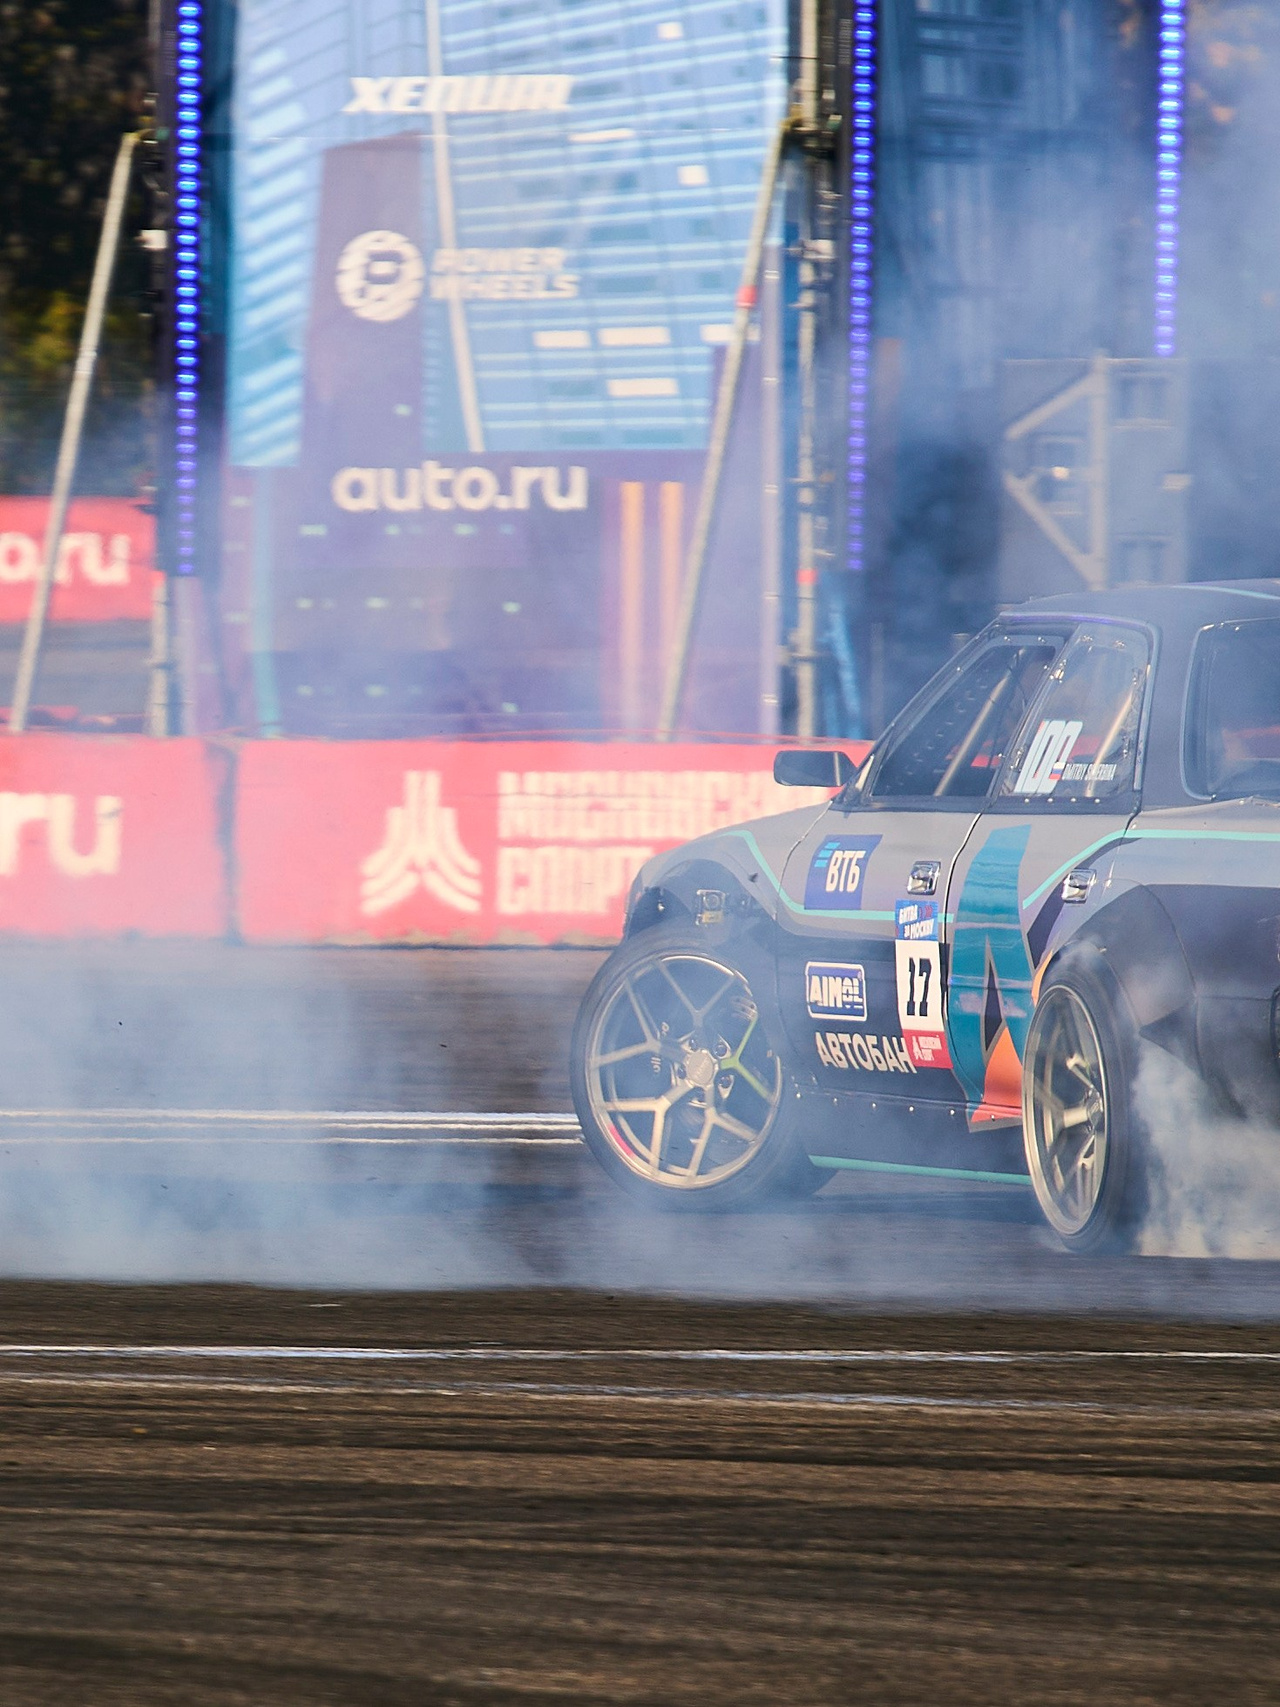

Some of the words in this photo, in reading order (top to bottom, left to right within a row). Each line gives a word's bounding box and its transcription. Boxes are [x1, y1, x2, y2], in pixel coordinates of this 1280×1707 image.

[429, 275, 580, 299] WHEELS
[331, 460, 589, 512] auto.ru
[825, 850, 867, 893] ВТБ
[809, 975, 864, 1009] AIMOL
[906, 957, 932, 1017] 17
[814, 1031, 917, 1074] АВТОБАН
